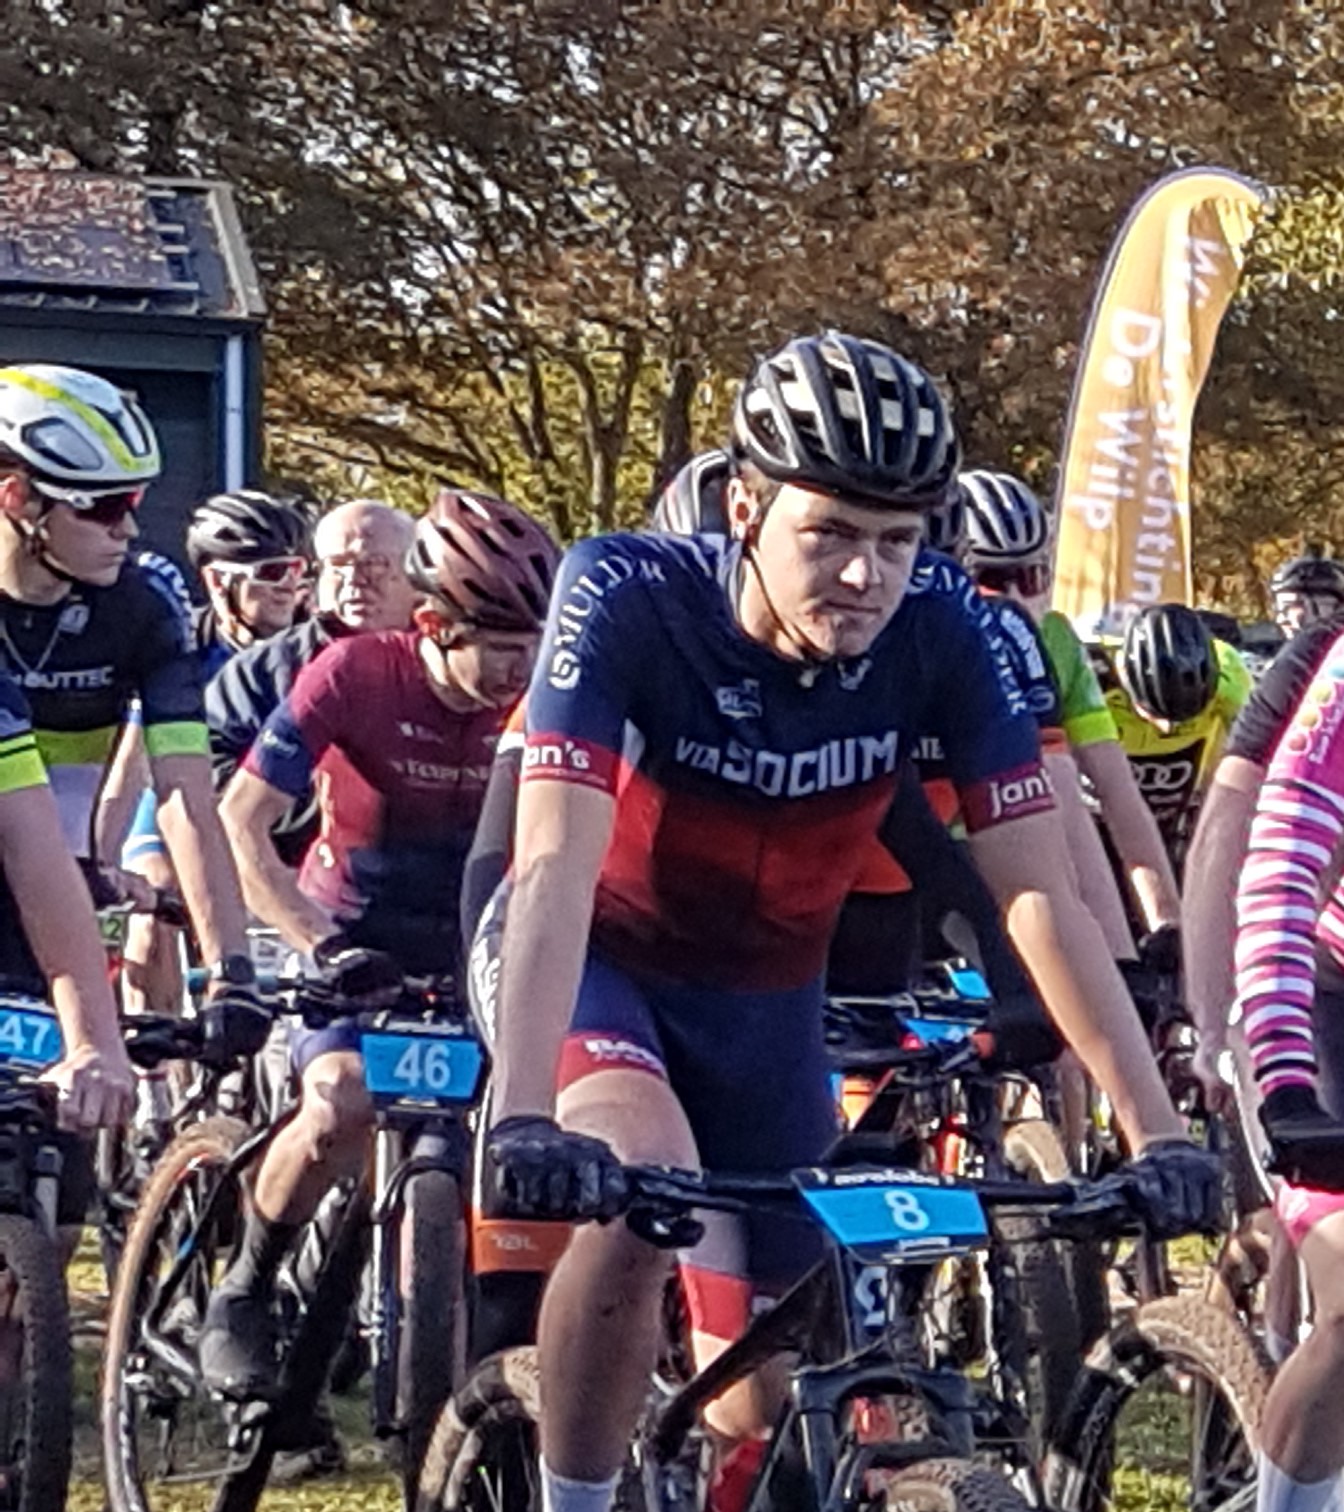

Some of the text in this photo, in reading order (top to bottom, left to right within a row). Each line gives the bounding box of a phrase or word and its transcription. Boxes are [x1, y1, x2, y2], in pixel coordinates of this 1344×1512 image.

[1068, 307, 1161, 531] De Wilp
[721, 730, 899, 798] SOCIUM
[0, 1013, 52, 1055] 47
[393, 1040, 451, 1089] 46
[883, 1189, 929, 1231] 8
